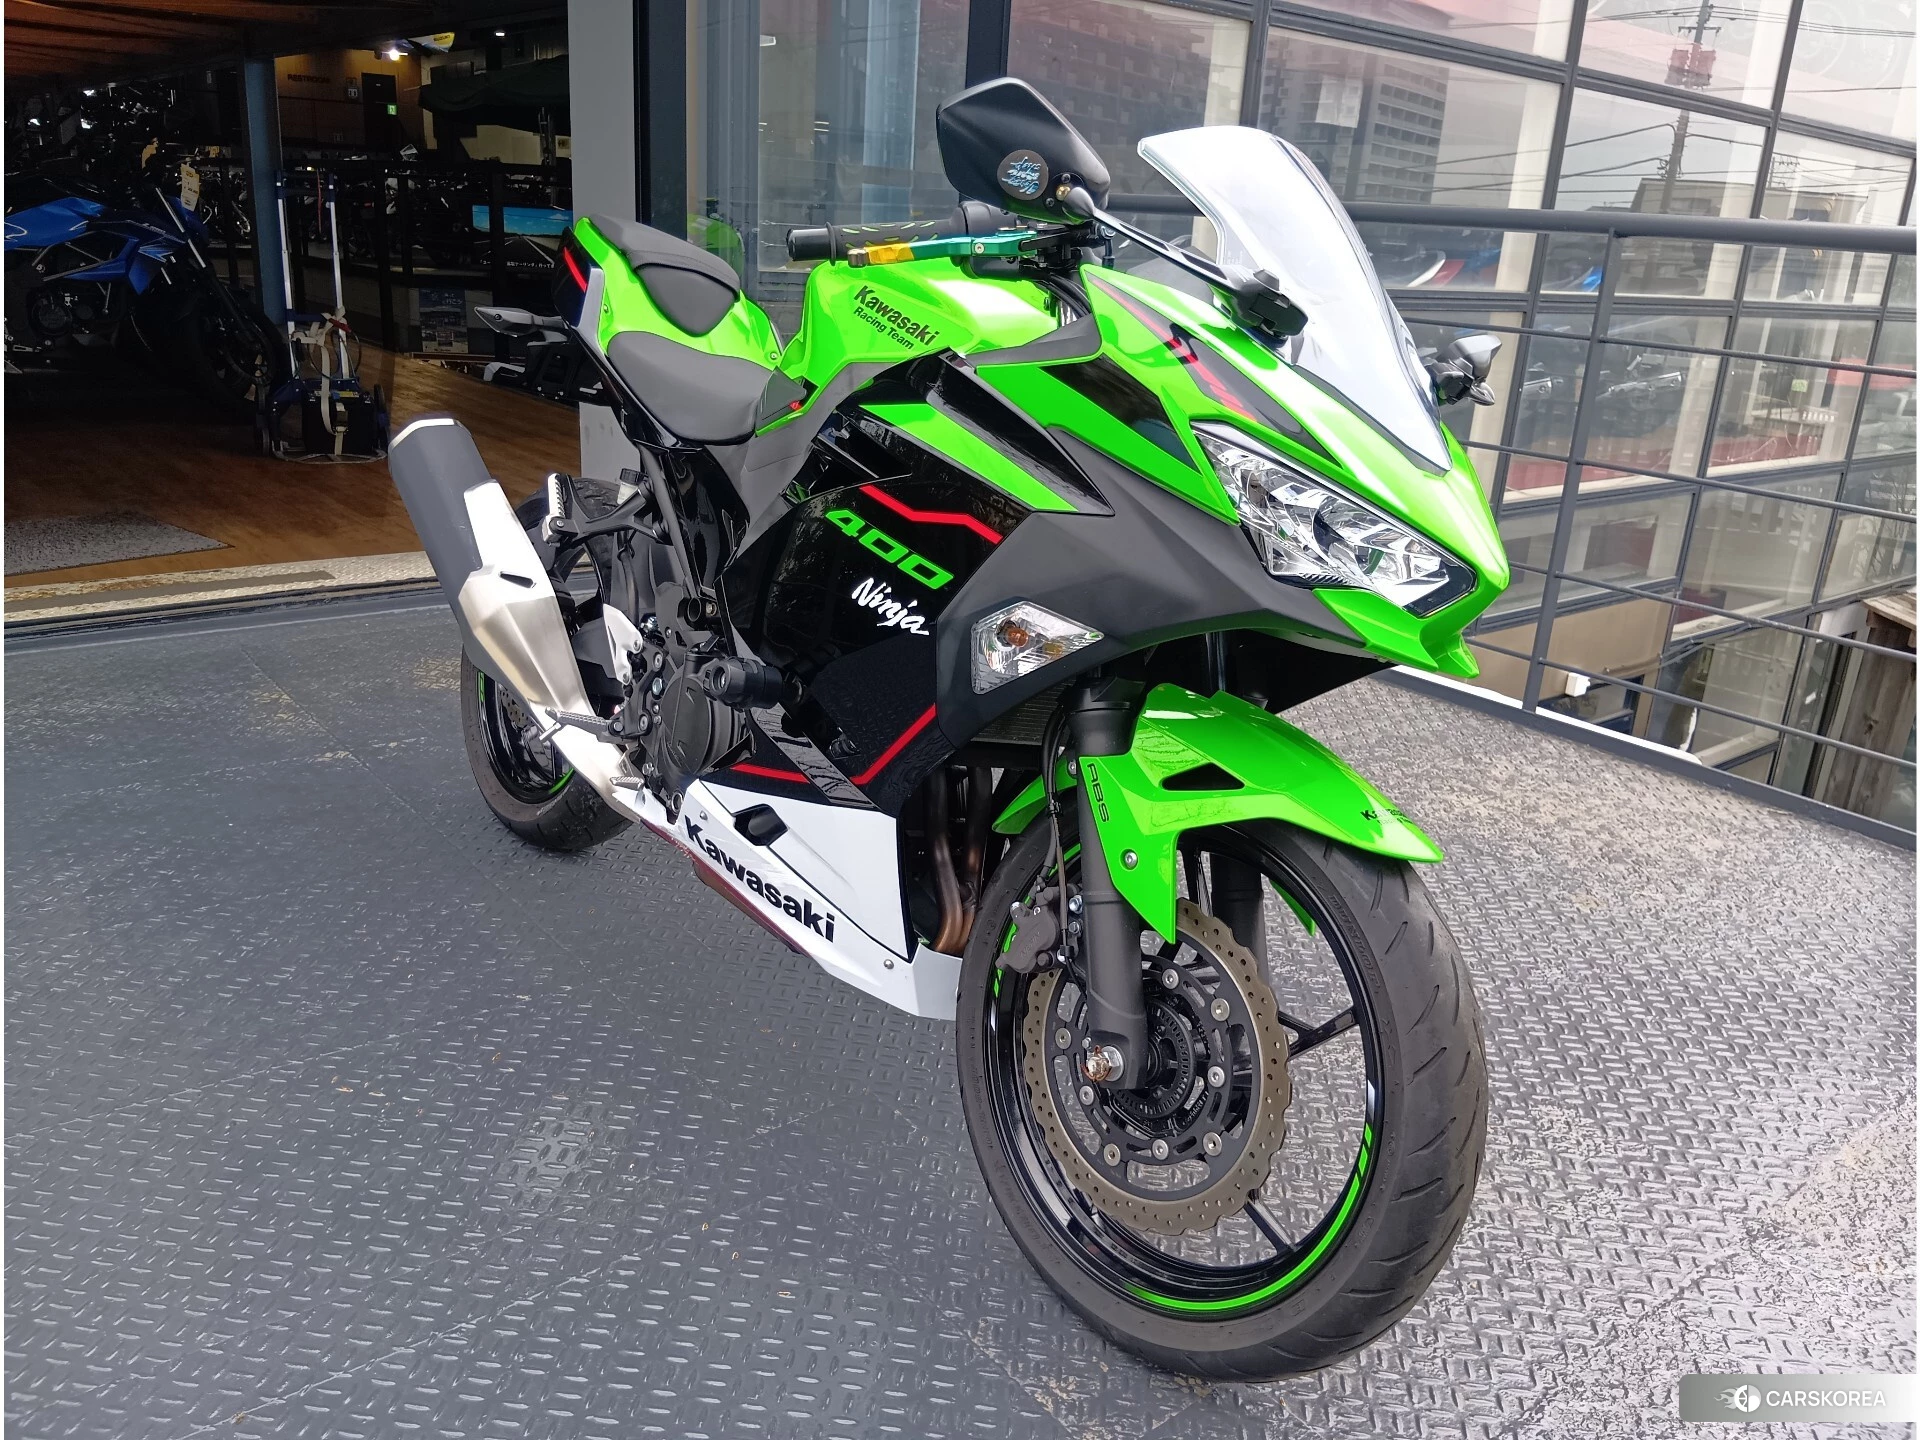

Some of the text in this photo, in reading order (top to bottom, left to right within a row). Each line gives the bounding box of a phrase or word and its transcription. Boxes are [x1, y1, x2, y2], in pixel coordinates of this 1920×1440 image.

[853, 306, 915, 350] Racing Team
[854, 285, 940, 346] Kawasaki
[825, 509, 955, 590] 400
[851, 577, 930, 635] Ninja
[1087, 763, 1109, 822] ABS
[684, 815, 835, 943] Kawasaki
